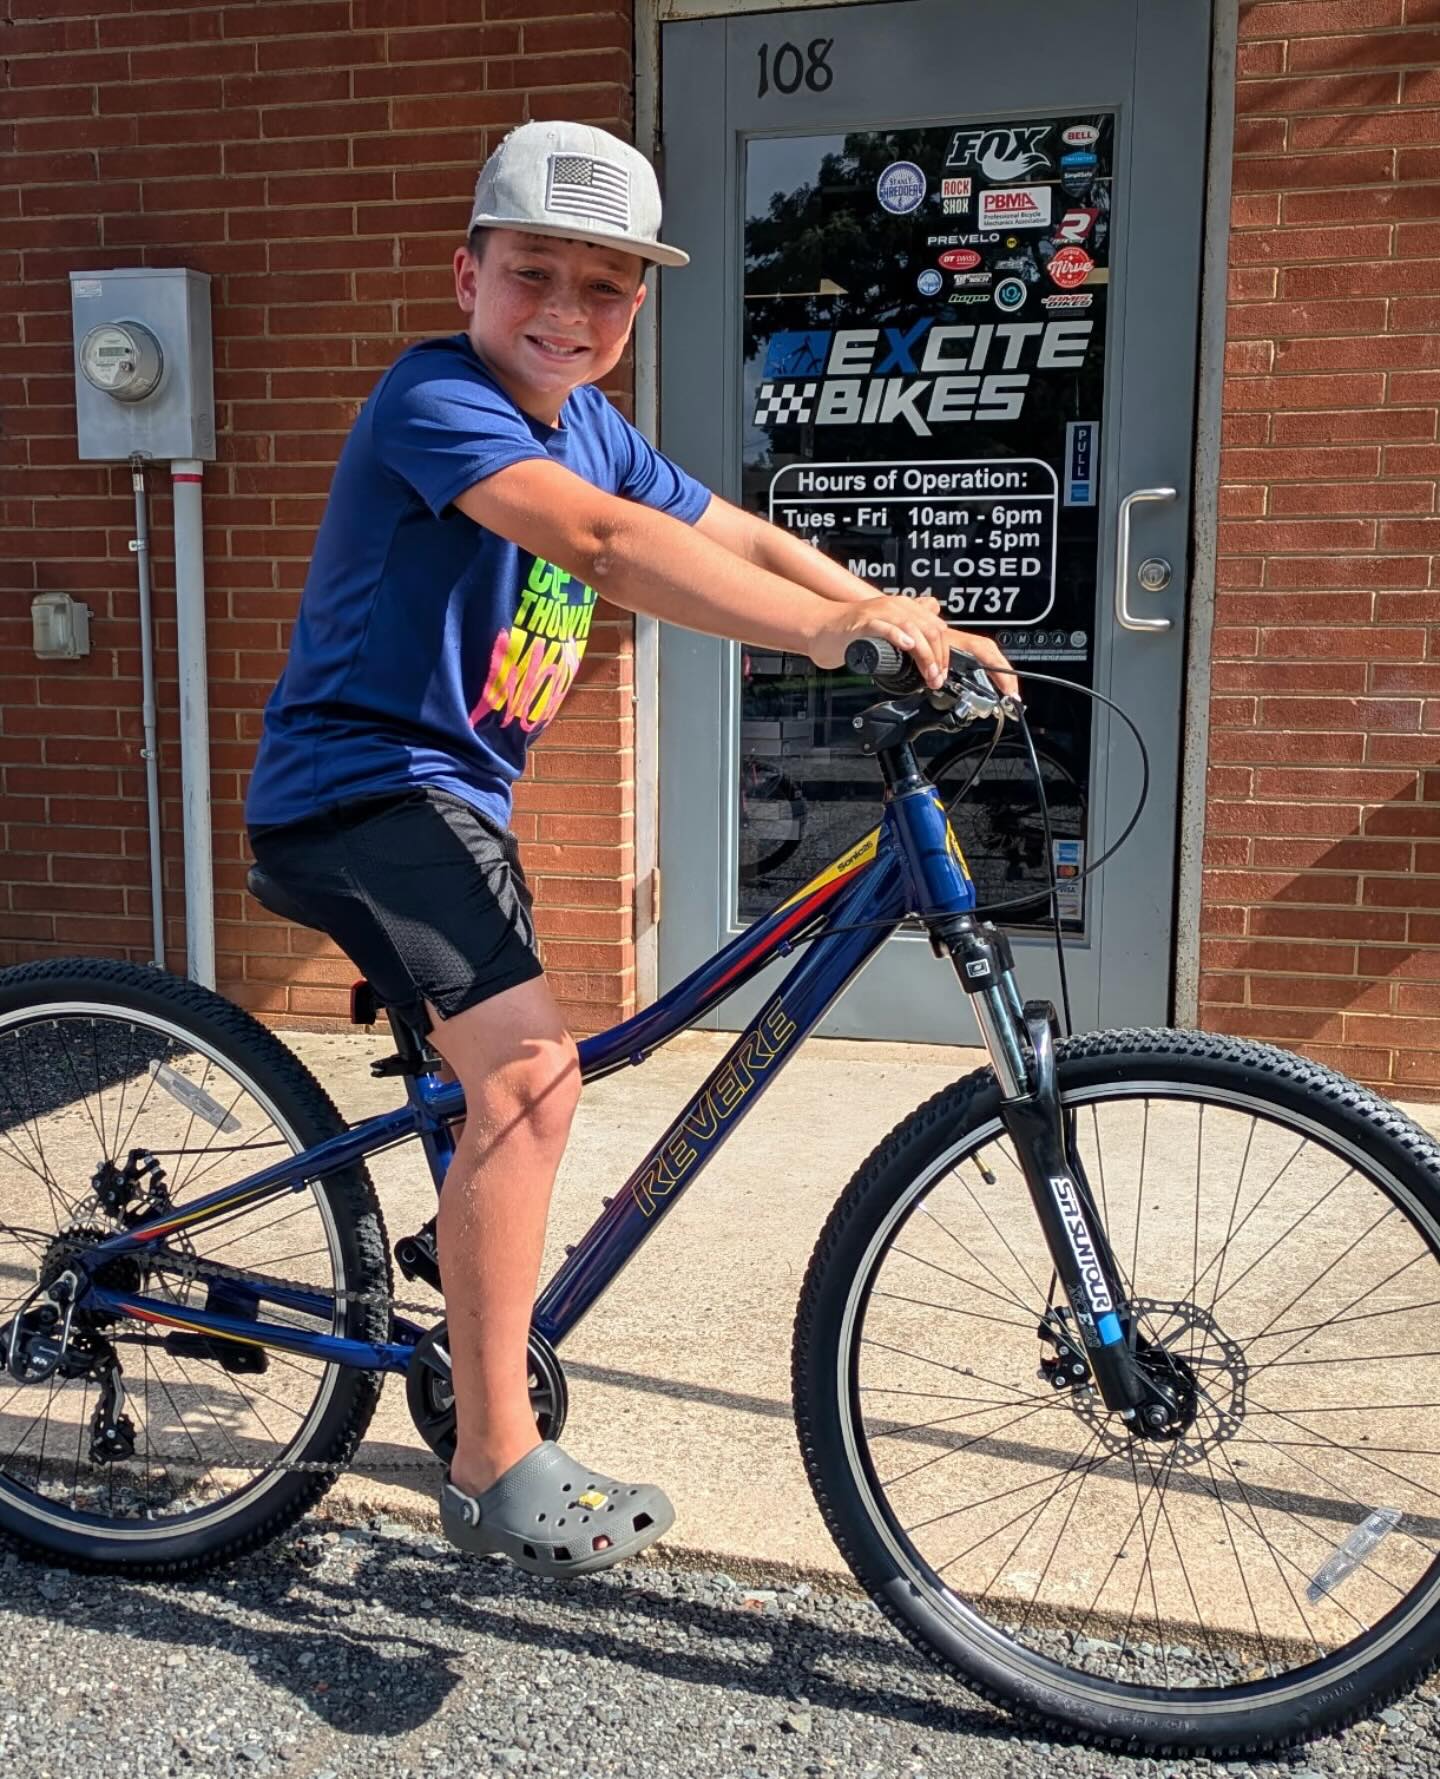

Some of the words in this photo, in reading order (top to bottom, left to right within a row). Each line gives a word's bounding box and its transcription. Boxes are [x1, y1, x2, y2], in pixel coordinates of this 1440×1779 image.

[757, 38, 834, 99] 108
[1067, 131, 1092, 140] BELL
[945, 126, 1052, 180] FOX
[944, 179, 970, 195] ROCK
[943, 198, 969, 214] SHOX
[984, 193, 1036, 210] PBMA
[1021, 210, 1041, 219] Bicycle
[927, 233, 1000, 245] PREVELO
[827, 317, 1094, 375] EXCITE
[815, 374, 1030, 436] BIKES
[1077, 429, 1088, 477] PULL
[798, 471, 866, 492] Hours
[873, 469, 897, 490] of
[904, 468, 1028, 494] Operation:
[783, 509, 835, 528] Tues
[858, 508, 888, 527] Fri
[908, 507, 969, 526] 10am
[991, 506, 1042, 531] 6pm
[907, 531, 969, 550] 11am
[988, 530, 1041, 553] 5pm
[849, 559, 896, 577] Mon
[911, 558, 1041, 577] CLOSED
[633, 996, 797, 1217] REVERE
[1067, 1217, 1112, 1311] SUNTOUR
